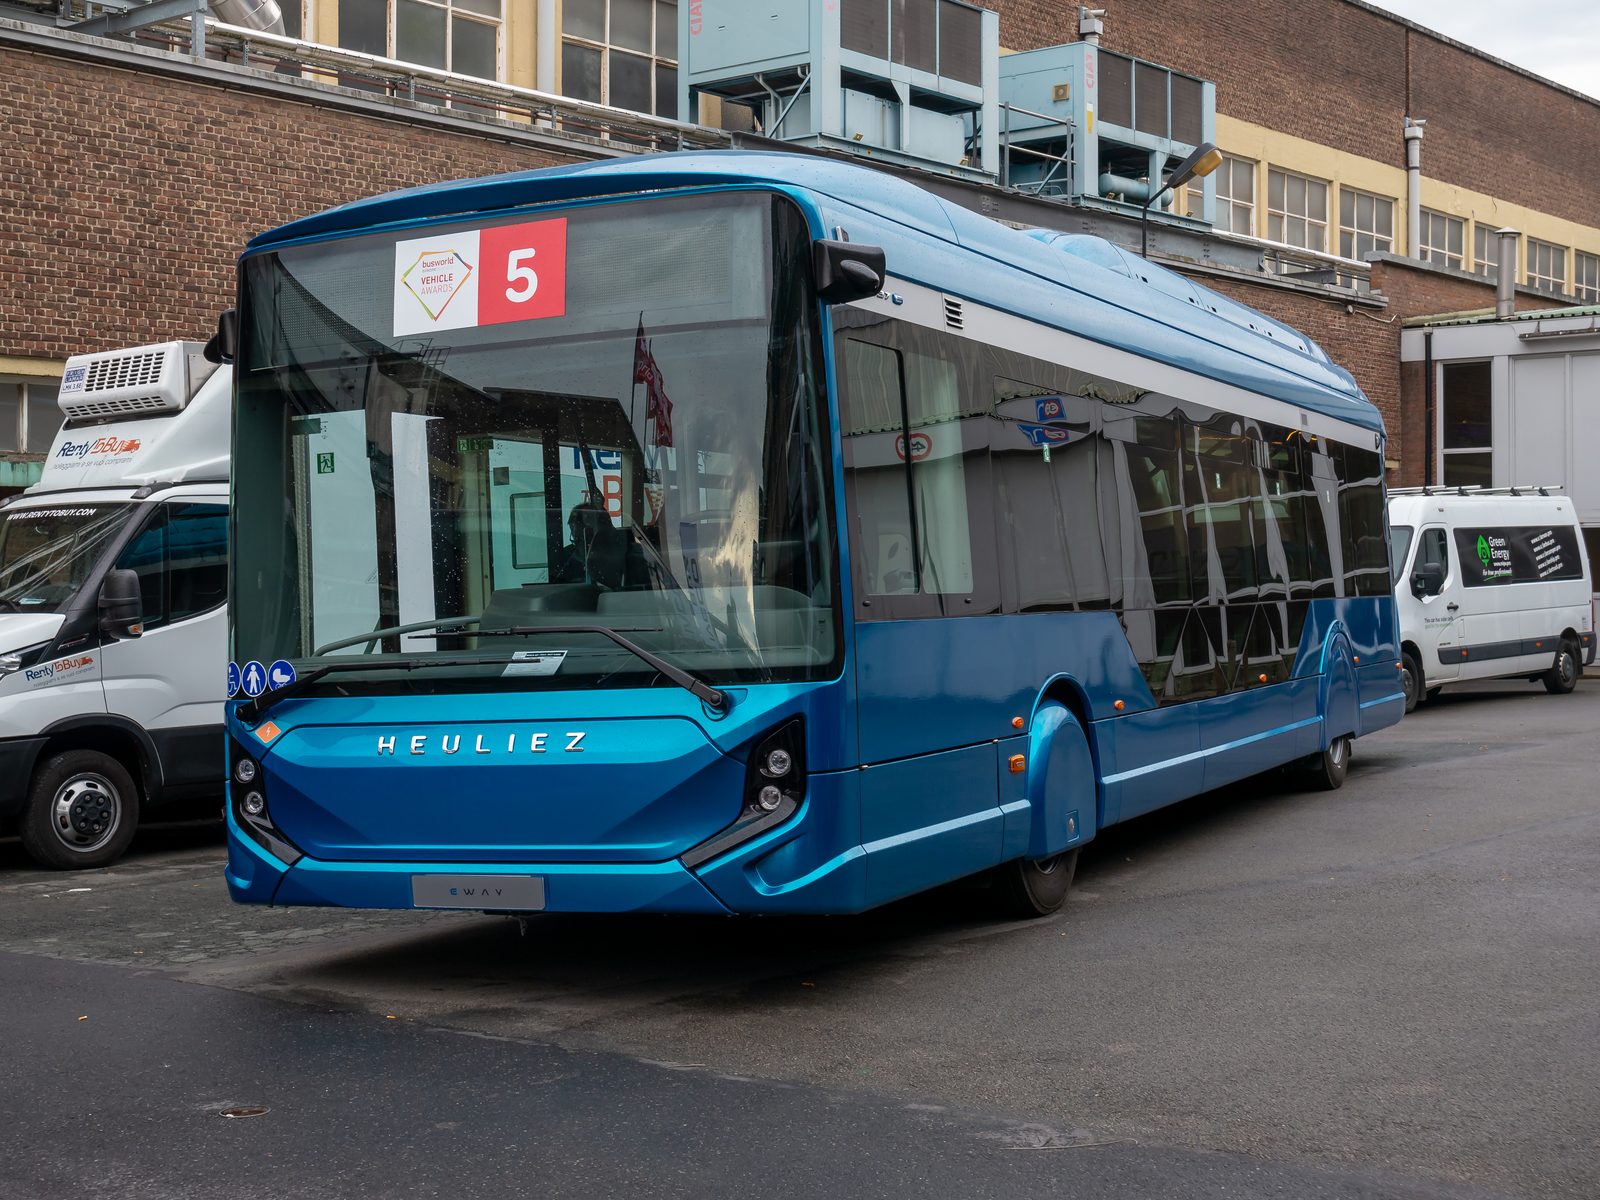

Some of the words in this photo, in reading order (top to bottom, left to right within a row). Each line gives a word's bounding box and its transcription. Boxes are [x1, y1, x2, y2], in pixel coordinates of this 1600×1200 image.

[422, 257, 454, 268] busworld
[421, 273, 453, 285] VEHICLE
[505, 247, 538, 303] 5
[421, 284, 453, 295] AWARDS
[6, 508, 97, 521] WWW.RENTYTOBUY.COM
[1488, 536, 1506, 547] Green
[1491, 548, 1510, 560] Energy
[376, 731, 587, 755] HEULIEZ
[449, 888, 503, 896] EWAY
